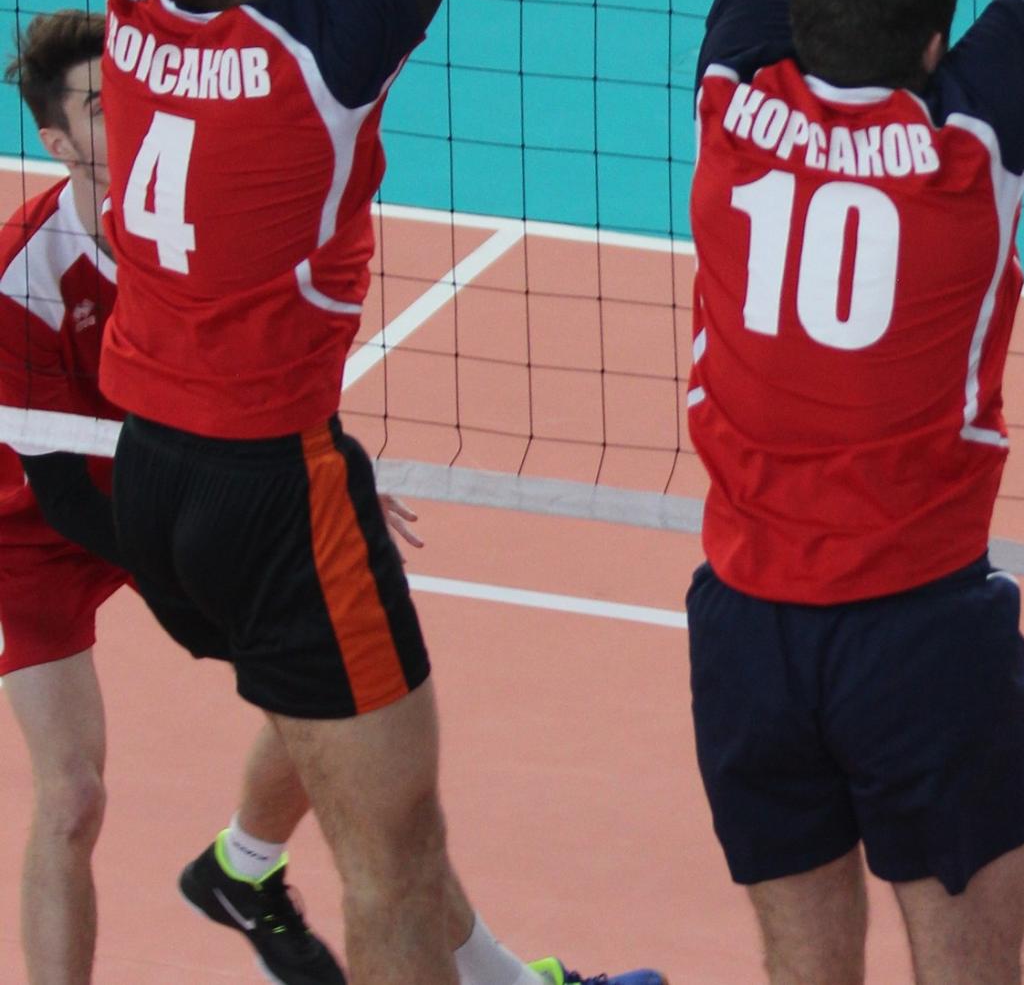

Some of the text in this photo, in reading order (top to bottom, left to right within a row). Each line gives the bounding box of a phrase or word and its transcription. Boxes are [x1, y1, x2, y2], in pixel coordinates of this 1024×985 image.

[122, 110, 197, 276] 4
[723, 82, 941, 179] КОРСАКОВ
[730, 168, 901, 351] 10
